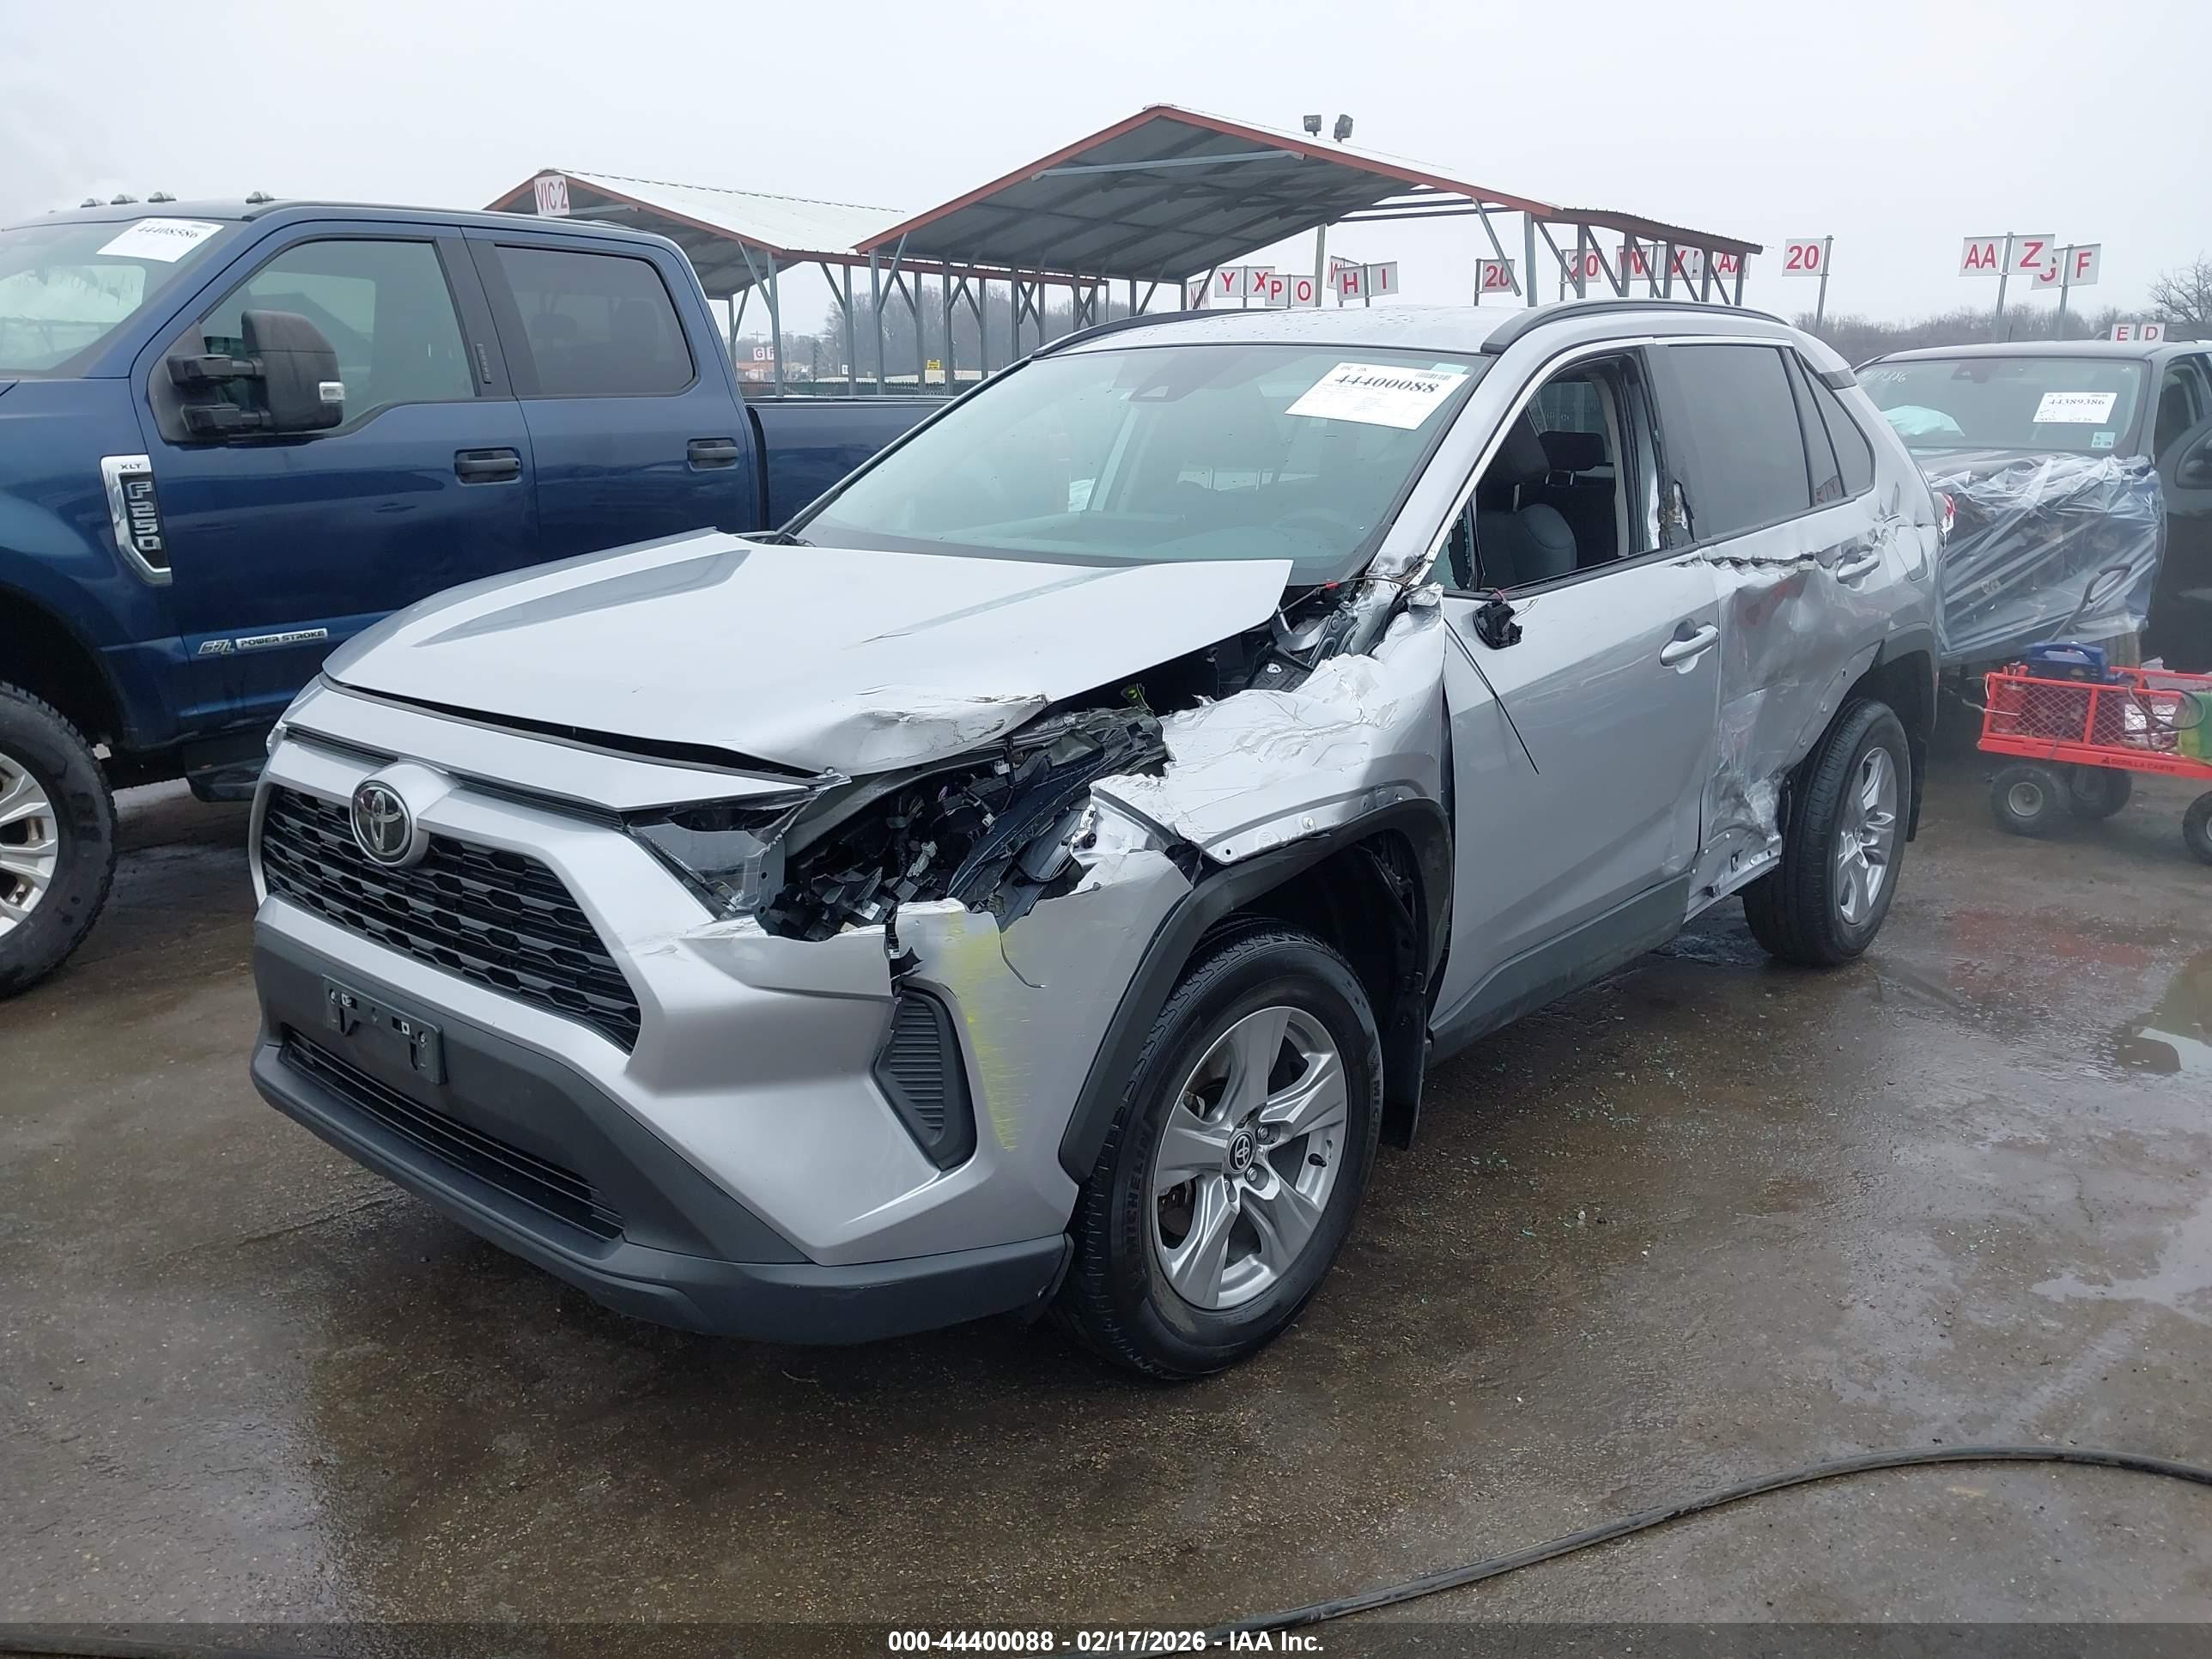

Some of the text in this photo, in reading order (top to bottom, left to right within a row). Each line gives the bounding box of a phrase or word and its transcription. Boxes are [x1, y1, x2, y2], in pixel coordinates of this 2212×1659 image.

[535, 180, 568, 211] VIC 2
[1786, 245, 1819, 270] 20
[1964, 243, 1996, 269] AA
[2020, 241, 2044, 268] Z
[1485, 264, 1510, 287] 20
[2076, 252, 2092, 279] F
[1220, 272, 1236, 292] Y
[1254, 272, 1268, 292] X
[1342, 272, 1358, 295] H
[1382, 268, 1387, 289] I
[1271, 281, 1283, 301] P
[1297, 281, 1311, 301] O
[2116, 326, 2130, 341] E
[2144, 326, 2159, 341] D
[756, 349, 763, 358] G
[1334, 374, 1440, 393] 44400088
[126, 481, 161, 551] F250
[240, 636, 279, 647] POWER
[282, 630, 325, 641] STROKE
